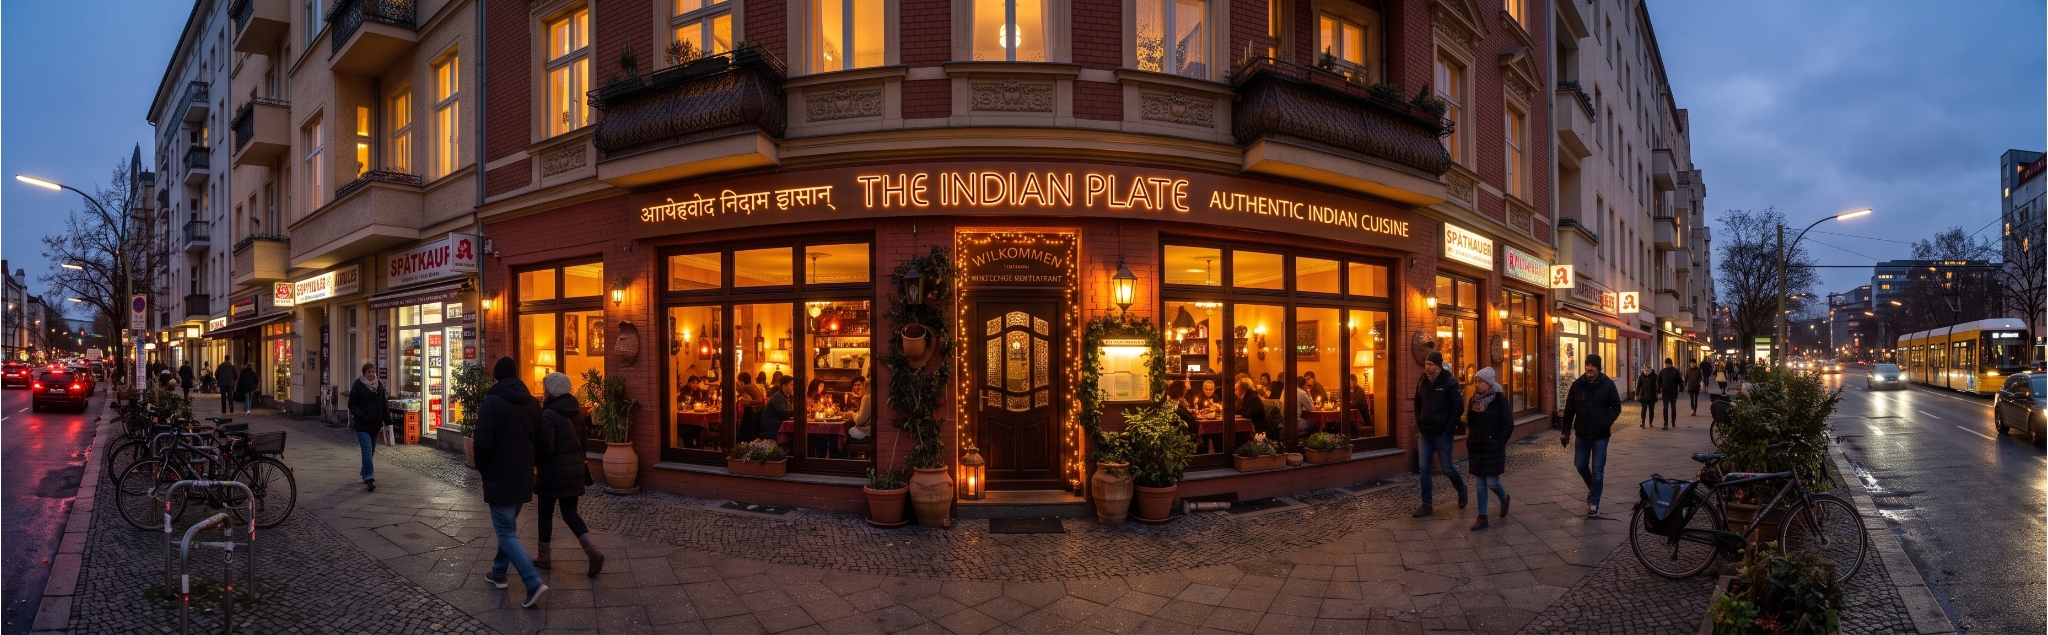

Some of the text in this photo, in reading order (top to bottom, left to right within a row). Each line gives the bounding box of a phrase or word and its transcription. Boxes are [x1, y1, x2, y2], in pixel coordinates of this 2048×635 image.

[720, 189, 771, 215] निदाम
[857, 172, 1190, 211] THE INDIAN PLATE
[1209, 190, 1409, 238] AUTHENTIC INDIAN CUISINE
[971, 247, 1063, 269] WILKOMMEN
